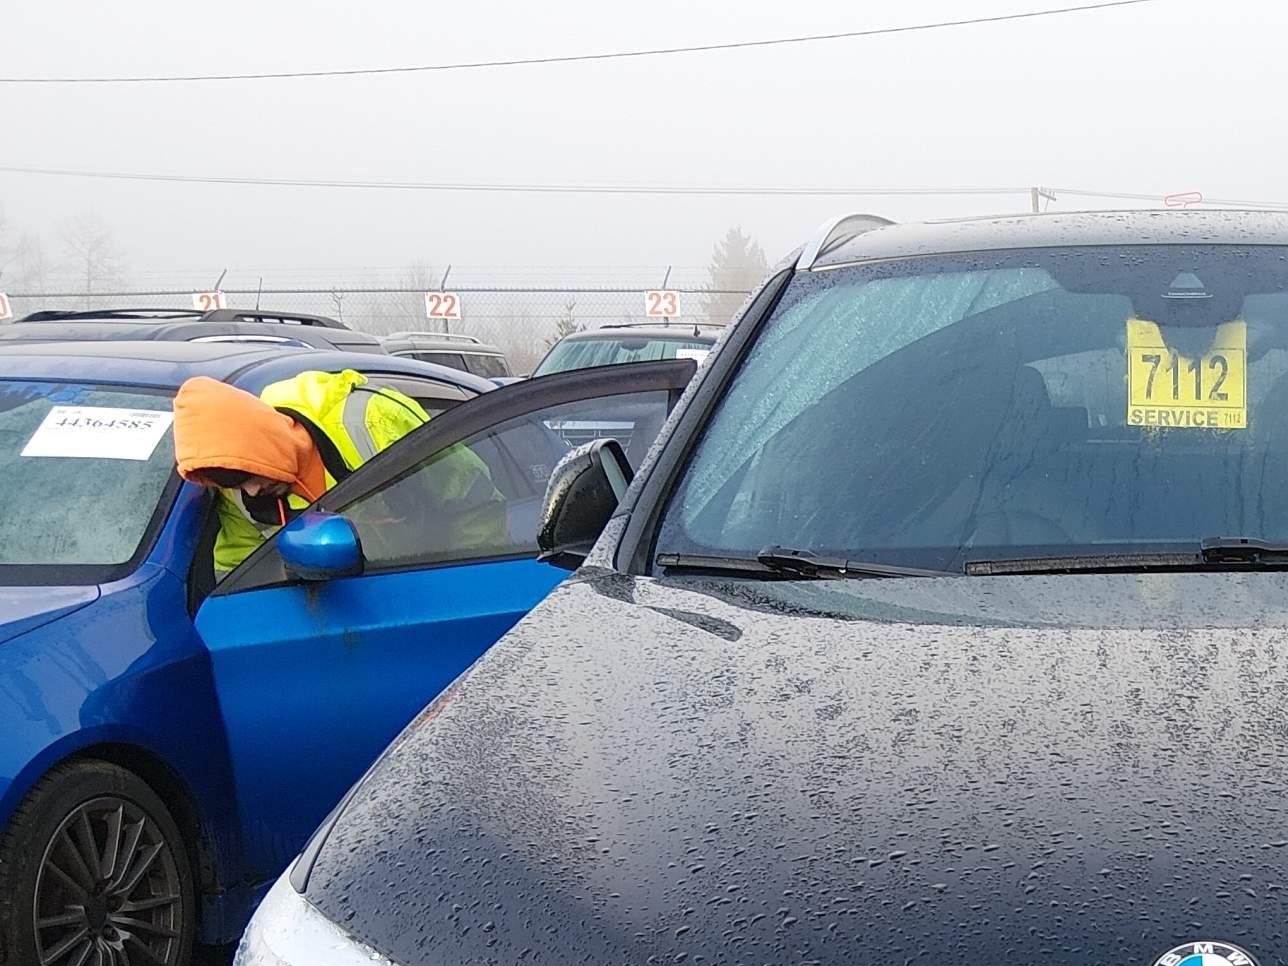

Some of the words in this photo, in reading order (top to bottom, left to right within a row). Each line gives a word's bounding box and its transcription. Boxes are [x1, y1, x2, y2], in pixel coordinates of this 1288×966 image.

[199, 294, 220, 310] 21
[429, 294, 457, 317] 22
[649, 292, 677, 316] 23
[1141, 353, 1228, 401] 7112
[56, 417, 154, 430] 44364585
[1131, 408, 1219, 427] SERVICE
[1223, 412, 1242, 425] 7112
